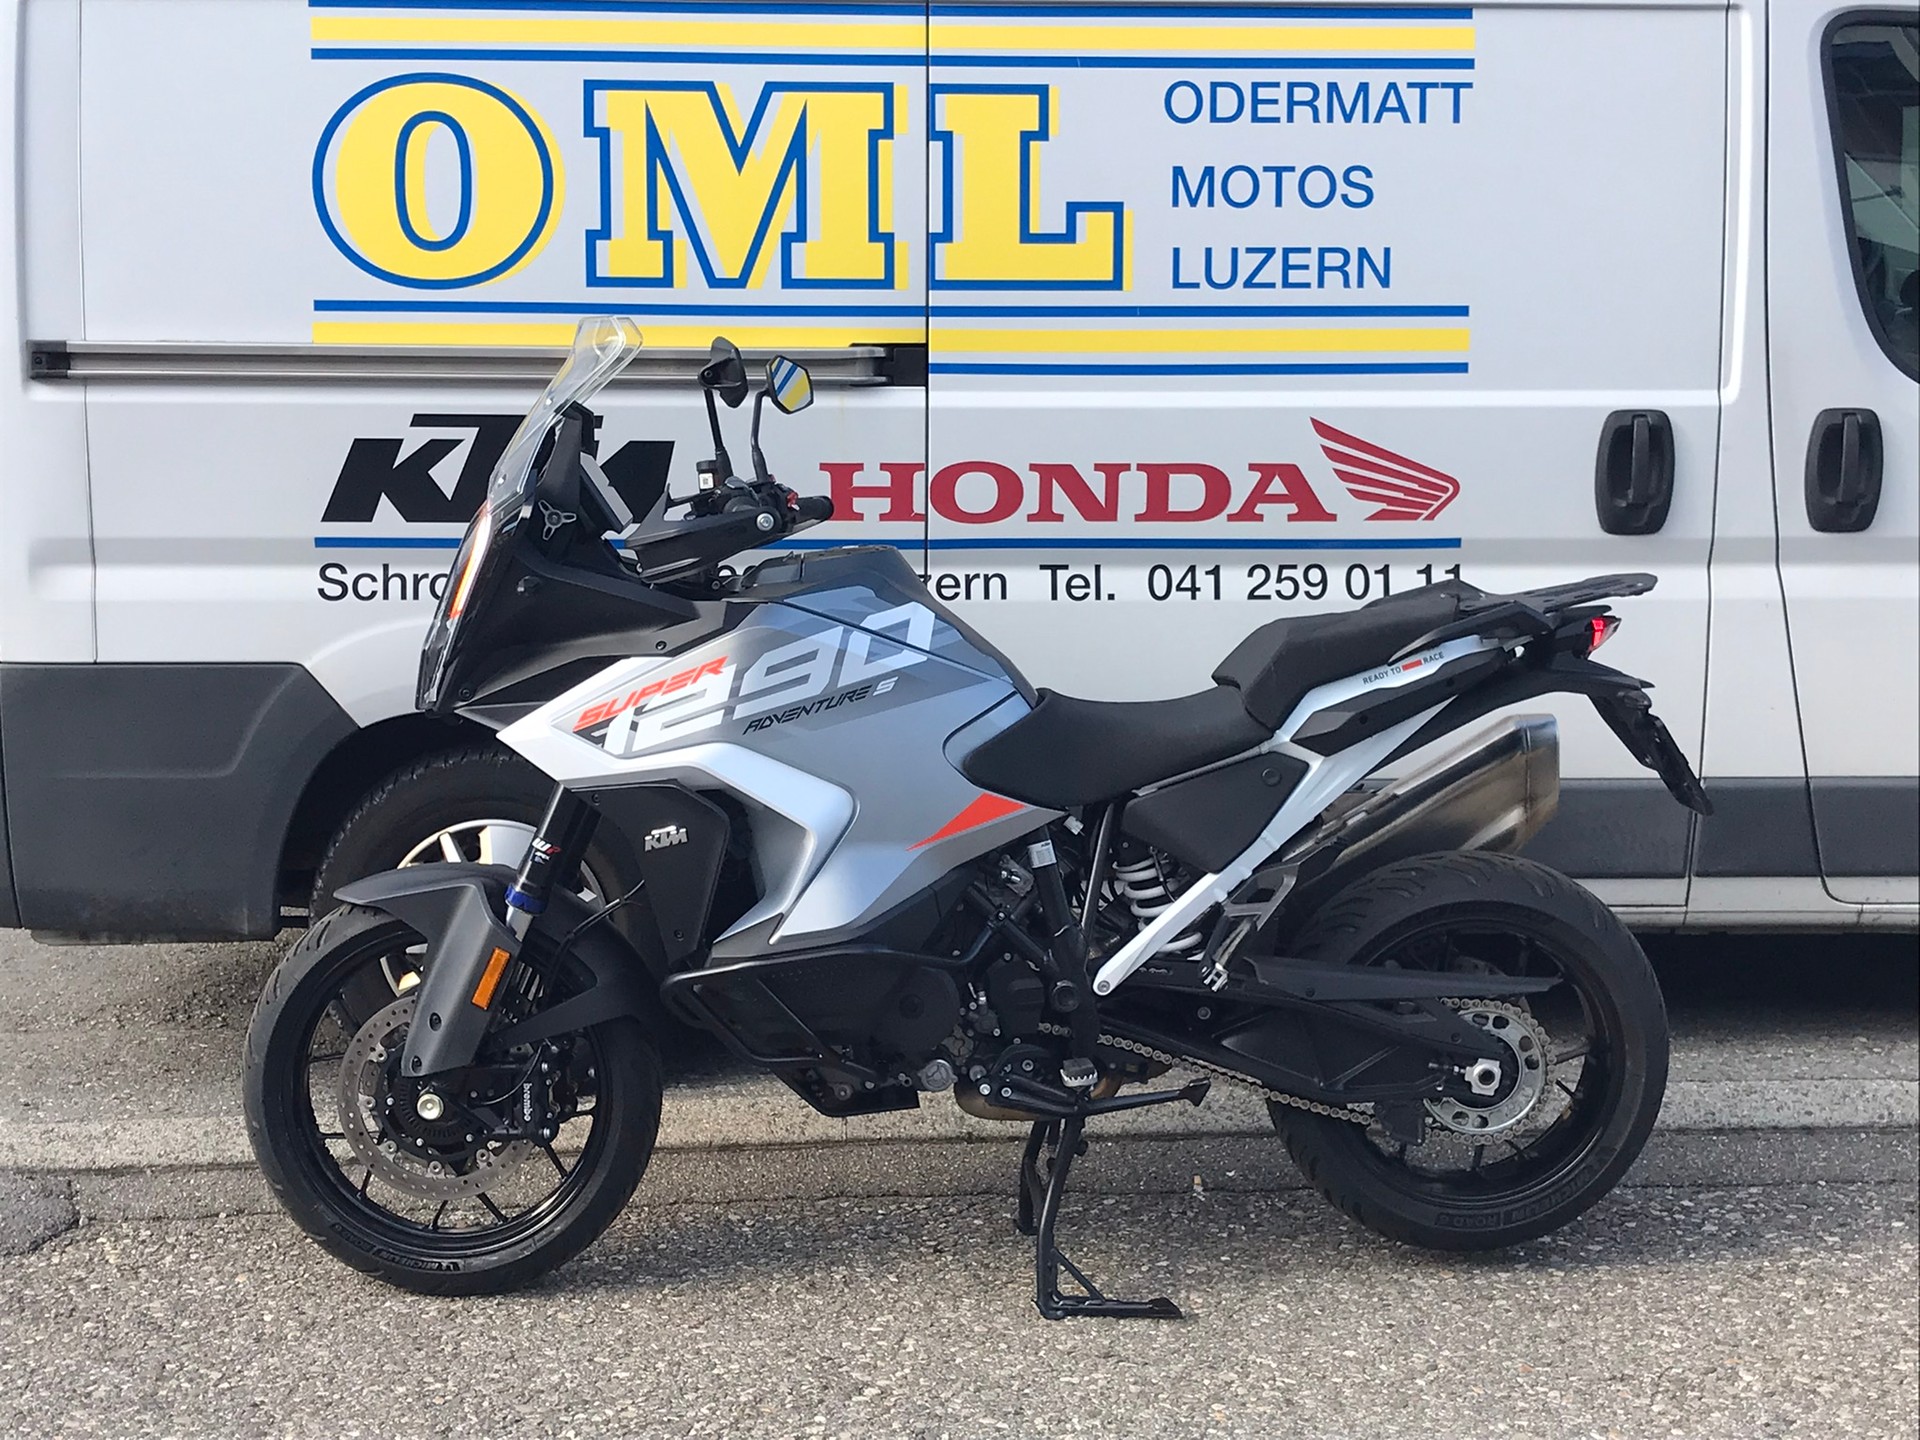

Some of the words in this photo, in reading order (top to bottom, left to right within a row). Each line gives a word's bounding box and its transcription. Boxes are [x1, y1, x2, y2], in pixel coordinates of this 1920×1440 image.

[1164, 80, 1474, 124] ODERMATT
[312, 72, 1133, 291] OML
[1171, 165, 1375, 209] MOTOS
[1171, 246, 1392, 289] LUZERN
[819, 461, 1338, 523] HONDA
[318, 562, 449, 601] Schro
[1040, 565, 1116, 600] Tel.
[1147, 564, 1222, 601] 041
[1247, 564, 1328, 601] 259
[1345, 564, 1391, 600] 01
[590, 602, 935, 755] 1290
[1362, 671, 1389, 685] READY
[1390, 666, 1402, 675] TO
[1422, 652, 1445, 665] RACE
[573, 656, 728, 733] SUPER
[742, 685, 873, 735] ADVENTURE
[873, 676, 899, 696] S
[644, 825, 688, 852] KTM
[523, 1083, 533, 1122] brembo
